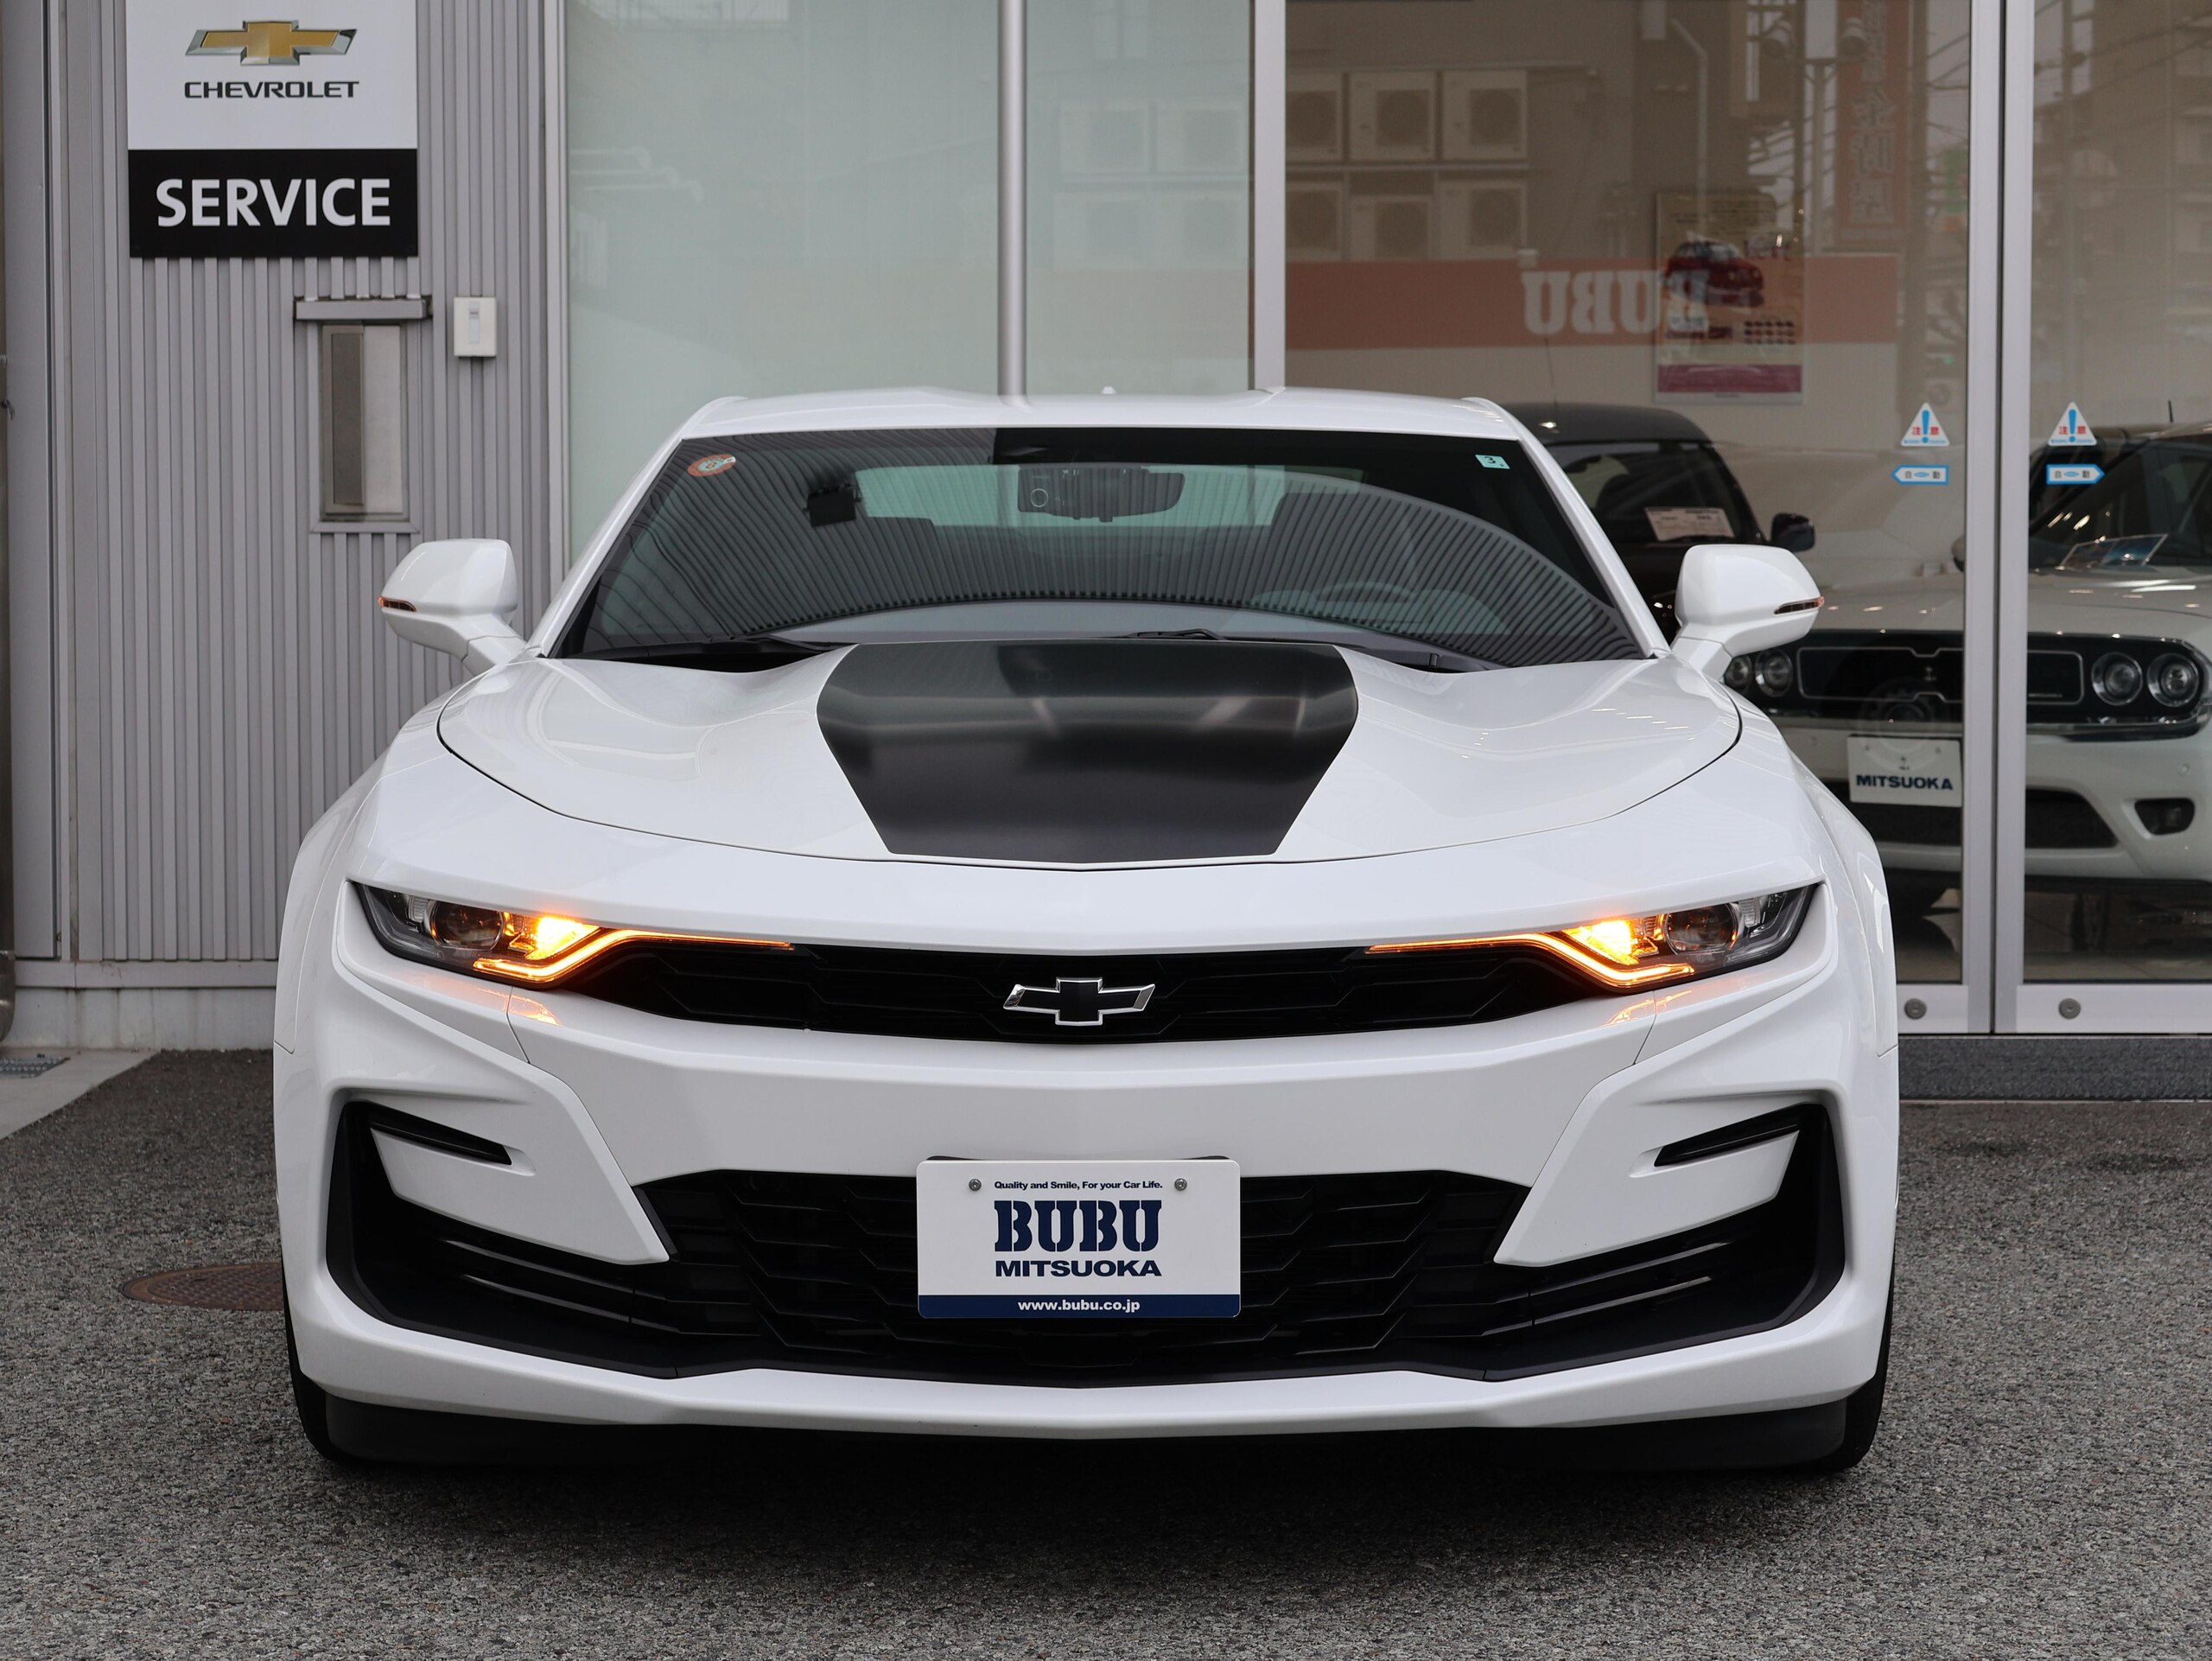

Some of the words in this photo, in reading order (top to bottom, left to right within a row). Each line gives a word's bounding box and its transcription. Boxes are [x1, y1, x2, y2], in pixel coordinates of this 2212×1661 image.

[184, 80, 359, 99] CHEVROLET
[156, 178, 391, 227] SERVICE
[1856, 774, 1954, 791] MITSUOKA
[994, 1181, 1028, 1191] Quality
[1030, 1181, 1048, 1189] and
[1051, 1181, 1080, 1191] Smile,
[1082, 1181, 1098, 1189] For
[1100, 1181, 1122, 1191] your
[1123, 1181, 1141, 1189] Car
[1142, 1181, 1163, 1189] Life.
[994, 1200, 1162, 1252] BUBU
[995, 1259, 1162, 1277] MITSUOKA
[1017, 1300, 1141, 1313] www.bubu.co.jp
